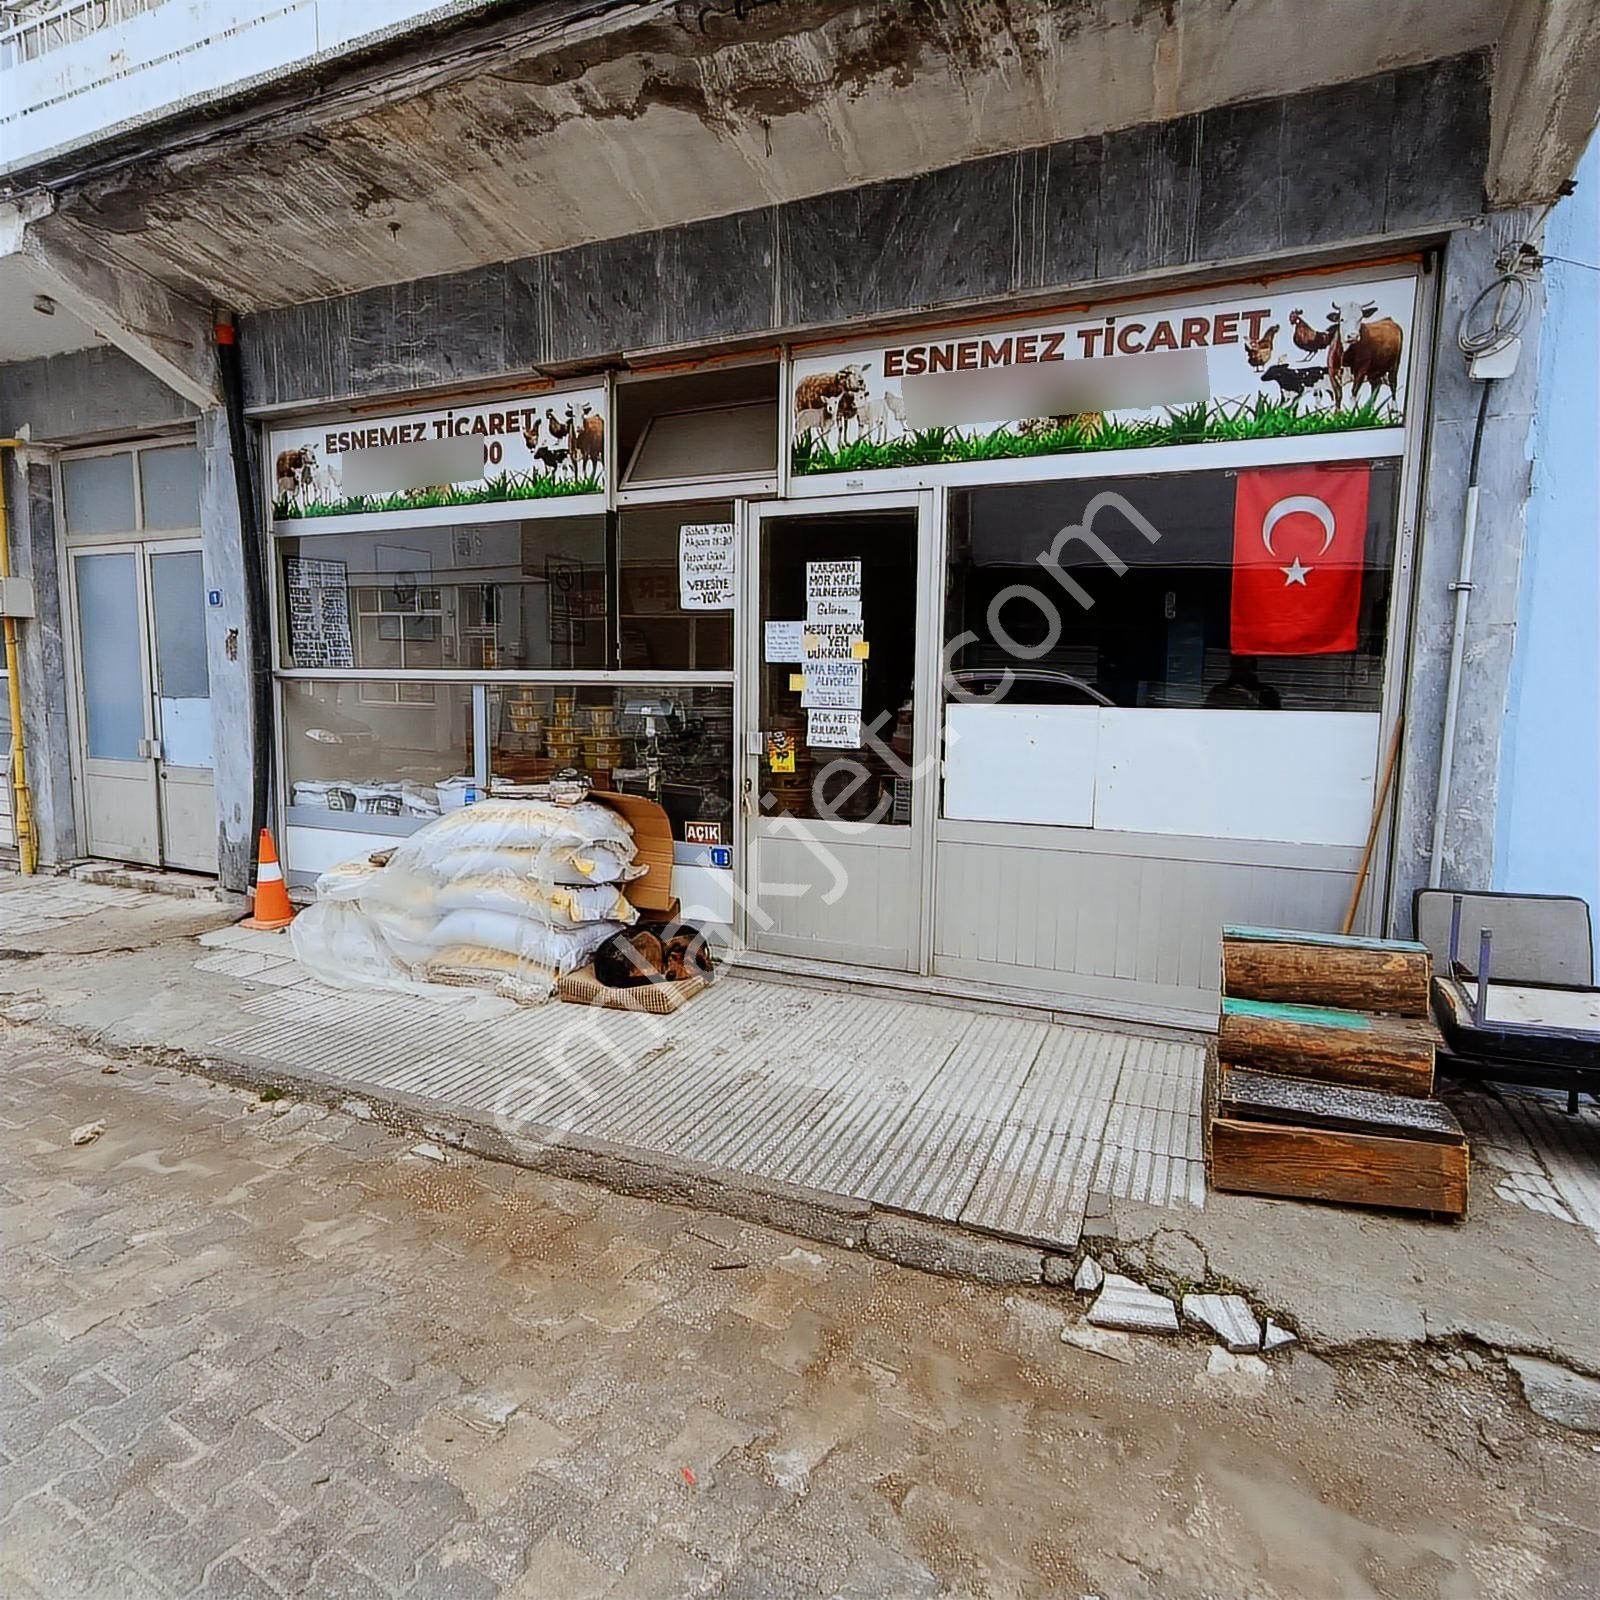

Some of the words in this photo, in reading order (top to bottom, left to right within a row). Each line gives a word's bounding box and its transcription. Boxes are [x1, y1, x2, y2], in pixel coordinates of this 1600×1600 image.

[883, 332, 1066, 377] ESNEMEZ
[1077, 309, 1272, 358] TİCARET
[325, 422, 427, 454] ESNEMEZ
[433, 407, 537, 438] TİCARET
[809, 575, 831, 586] MOR
[701, 590, 721, 605] YOK
[828, 635, 849, 647] YEM
[687, 825, 718, 842] AÇIK
